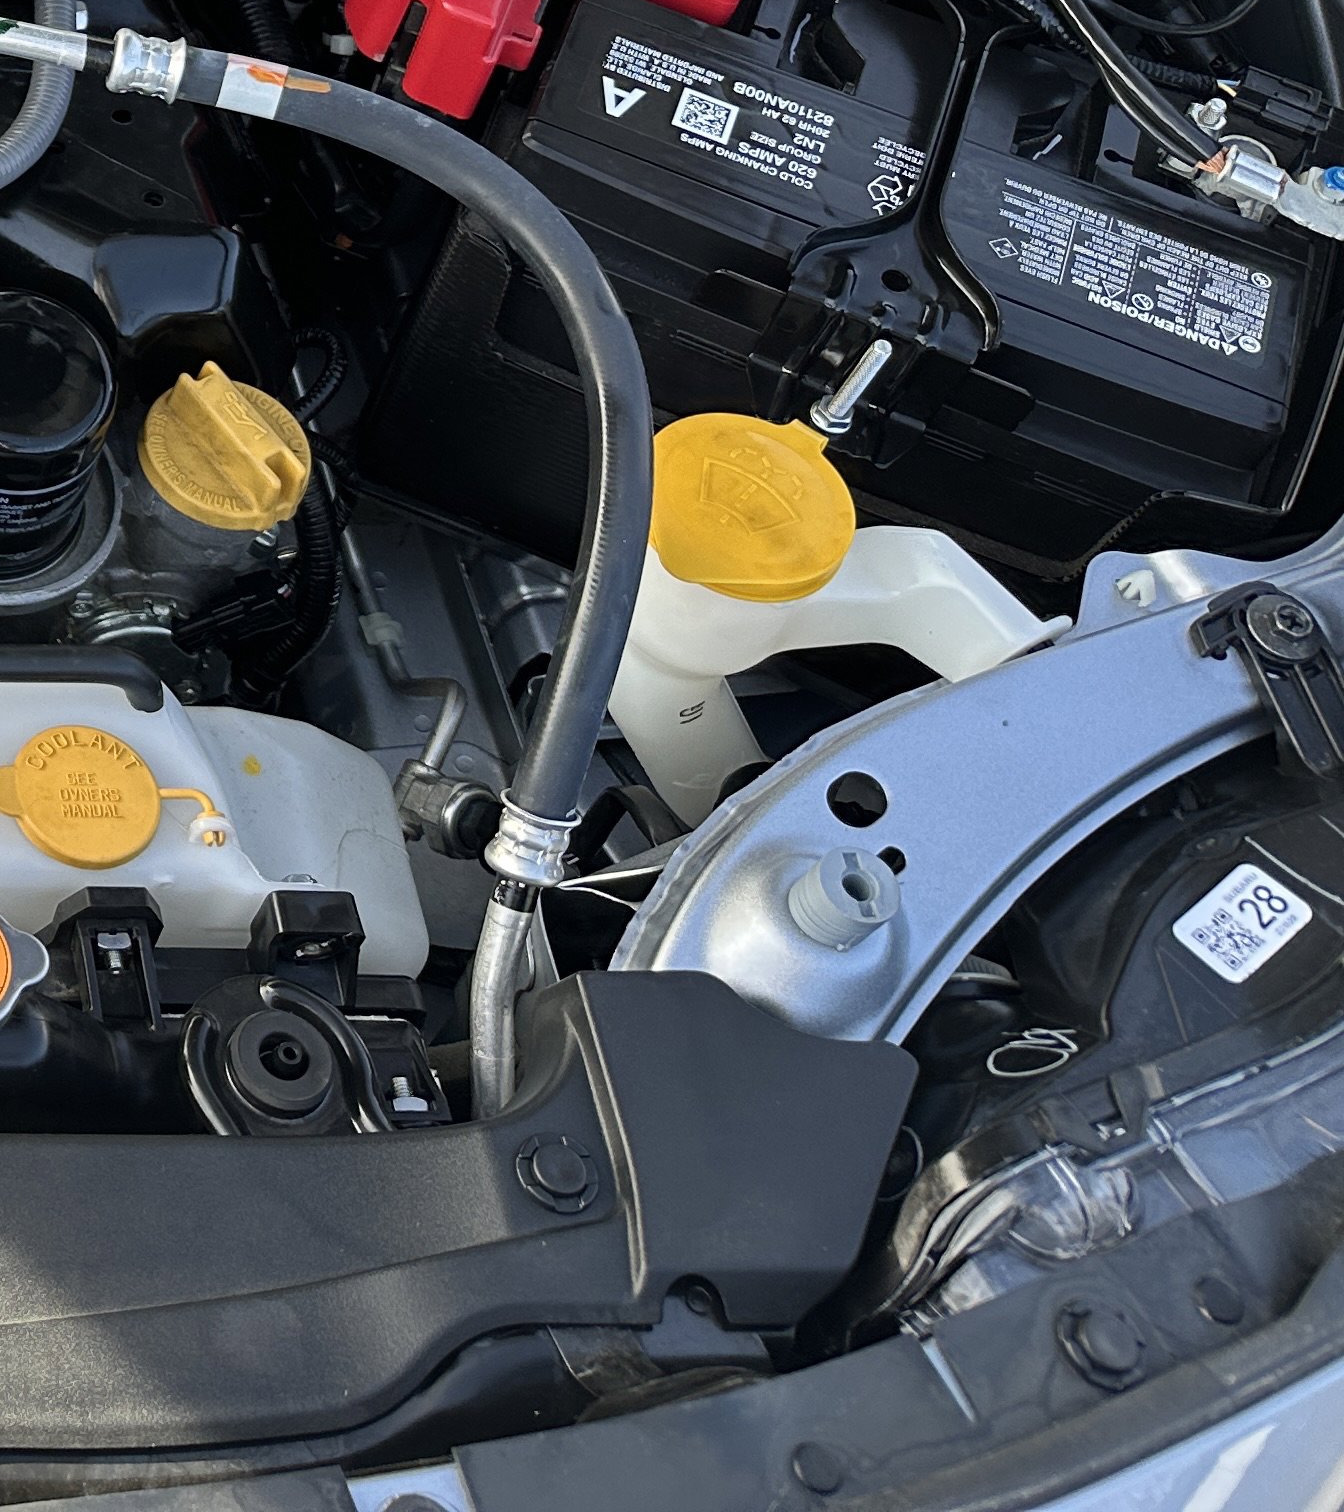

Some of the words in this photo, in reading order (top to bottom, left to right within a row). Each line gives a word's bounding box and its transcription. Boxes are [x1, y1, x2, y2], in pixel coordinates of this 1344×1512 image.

[614, 35, 661, 58] MATERIALS
[627, 48, 650, 62] WITH
[661, 52, 705, 74] IMPORTED
[676, 66, 686, 75] IN
[616, 66, 671, 92] DISTRIBUTED
[686, 70, 712, 84] MADE
[704, 69, 724, 82] AND
[592, 75, 647, 124] A
[732, 80, 834, 127] 82110AN00B
[761, 106, 781, 120] AH
[780, 113, 797, 126] 62
[748, 130, 777, 148] SIZE
[797, 119, 830, 138] 20HR
[678, 131, 714, 152] AMPS
[792, 132, 825, 153] LN2
[714, 145, 778, 176] CRANKING
[736, 140, 786, 168] AMPS
[777, 141, 822, 165] GROUP
[787, 159, 817, 179] 620
[778, 170, 813, 190] COLD
[1086, 290, 1220, 349] DANGER/POISON
[185, 479, 242, 513] MANUAL
[25, 730, 142, 770] COOLANT
[66, 773, 98, 786] SEE
[61, 804, 125, 819] MANUAL
[1238, 885, 1288, 929] 28
